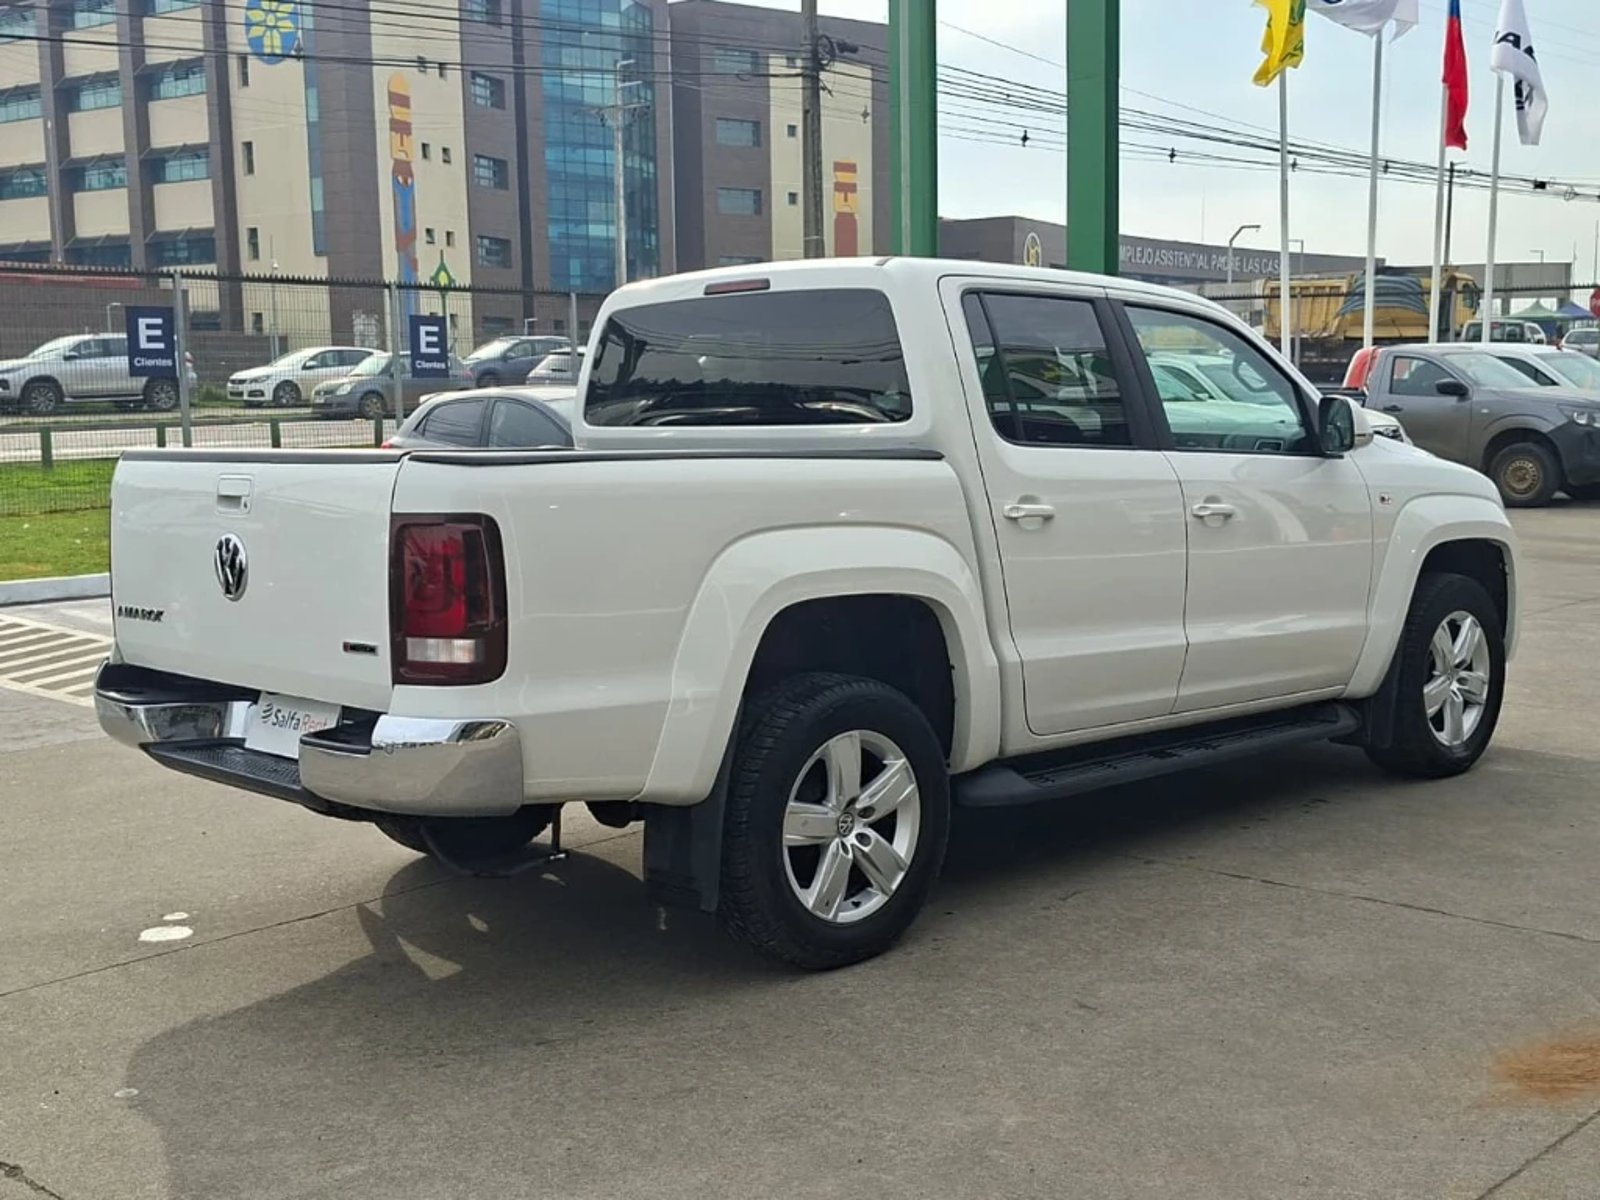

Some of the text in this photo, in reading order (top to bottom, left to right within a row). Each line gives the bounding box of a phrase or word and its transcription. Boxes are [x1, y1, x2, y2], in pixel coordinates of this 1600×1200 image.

[1243, 256, 1260, 273] LAS
[1261, 258, 1280, 275] CAS
[137, 317, 165, 349] E
[420, 326, 440, 354] E
[134, 357, 173, 367] Clientes
